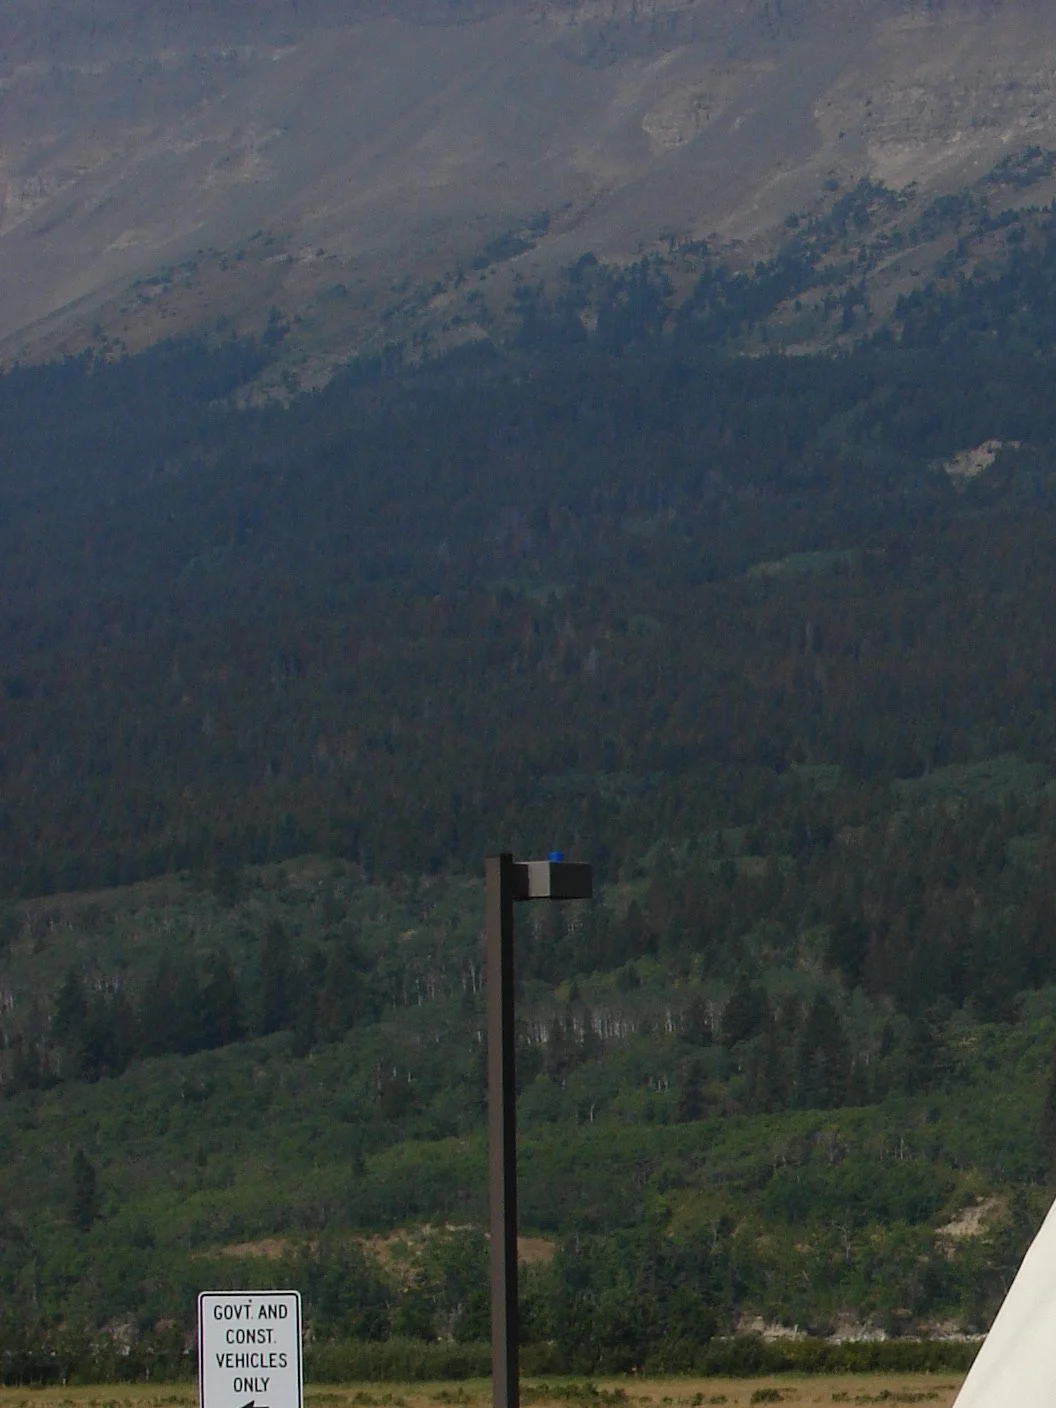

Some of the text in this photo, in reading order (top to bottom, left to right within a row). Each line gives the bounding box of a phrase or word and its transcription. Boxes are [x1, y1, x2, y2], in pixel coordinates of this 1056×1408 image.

[258, 1304, 288, 1319] AND
[226, 1329, 277, 1344] CONST.
[216, 1353, 288, 1368] VEHICLES
[233, 1377, 270, 1392] ONLY
